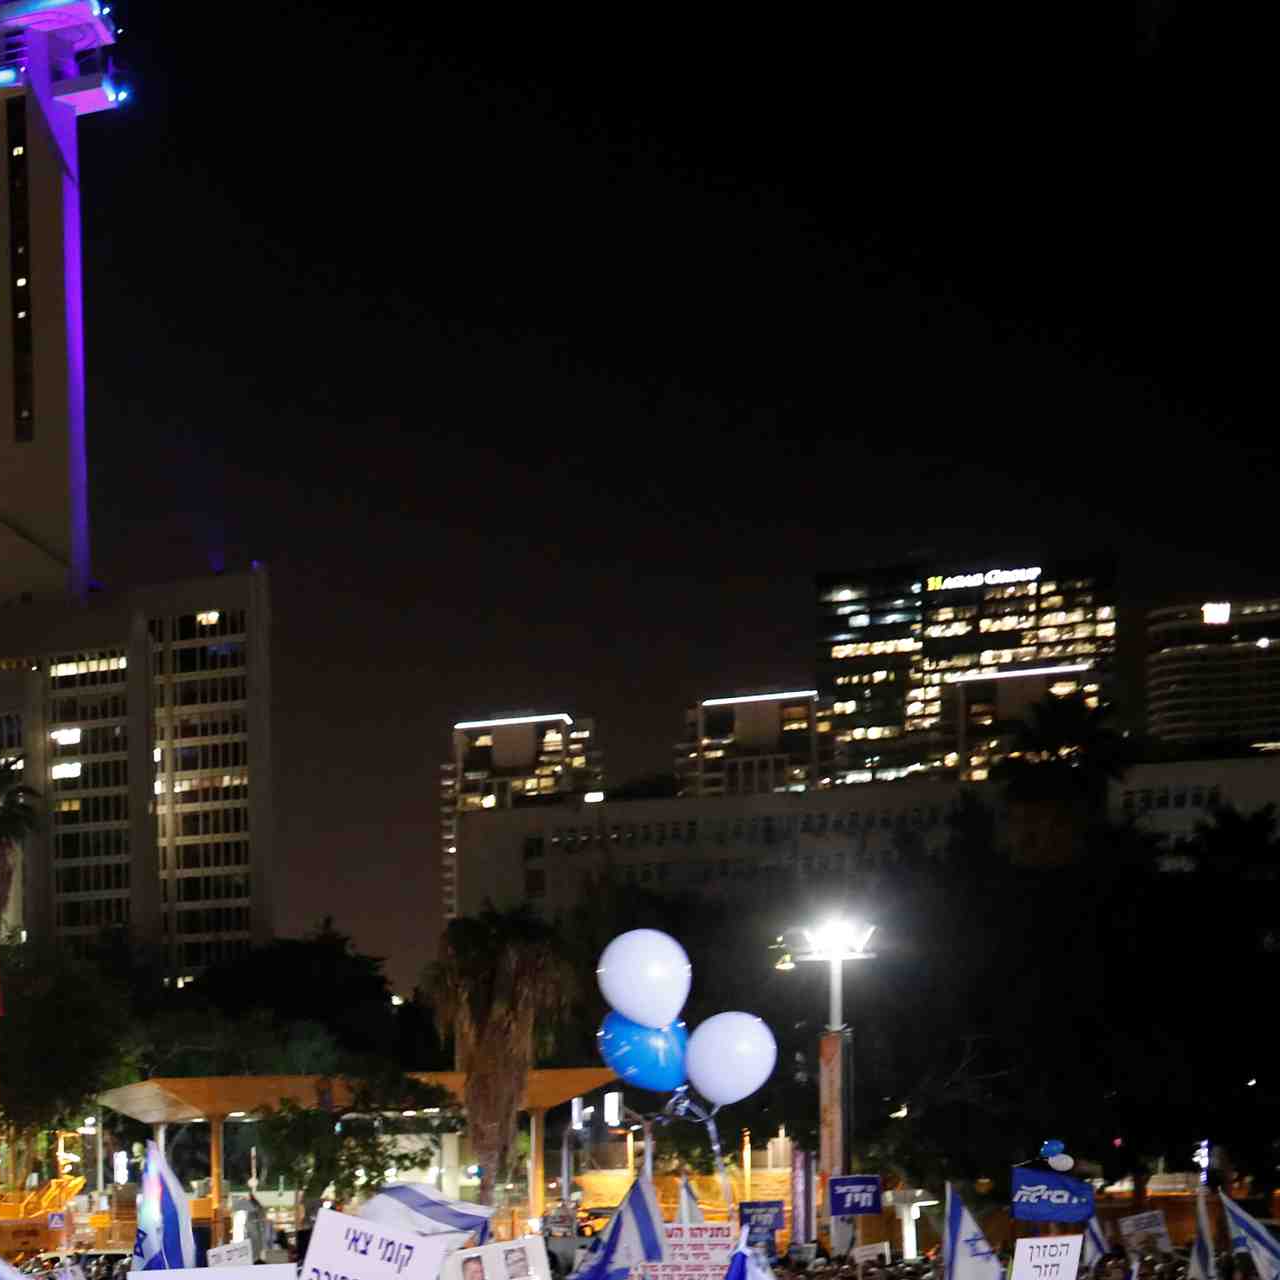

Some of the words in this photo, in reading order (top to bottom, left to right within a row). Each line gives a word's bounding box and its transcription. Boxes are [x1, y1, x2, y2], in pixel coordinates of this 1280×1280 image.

[345, 1227, 374, 1256] צאי
[1028, 1243, 1070, 1262] הסזון
[378, 1237, 414, 1274] קומי
[1032, 1263, 1060, 1279] חזר
